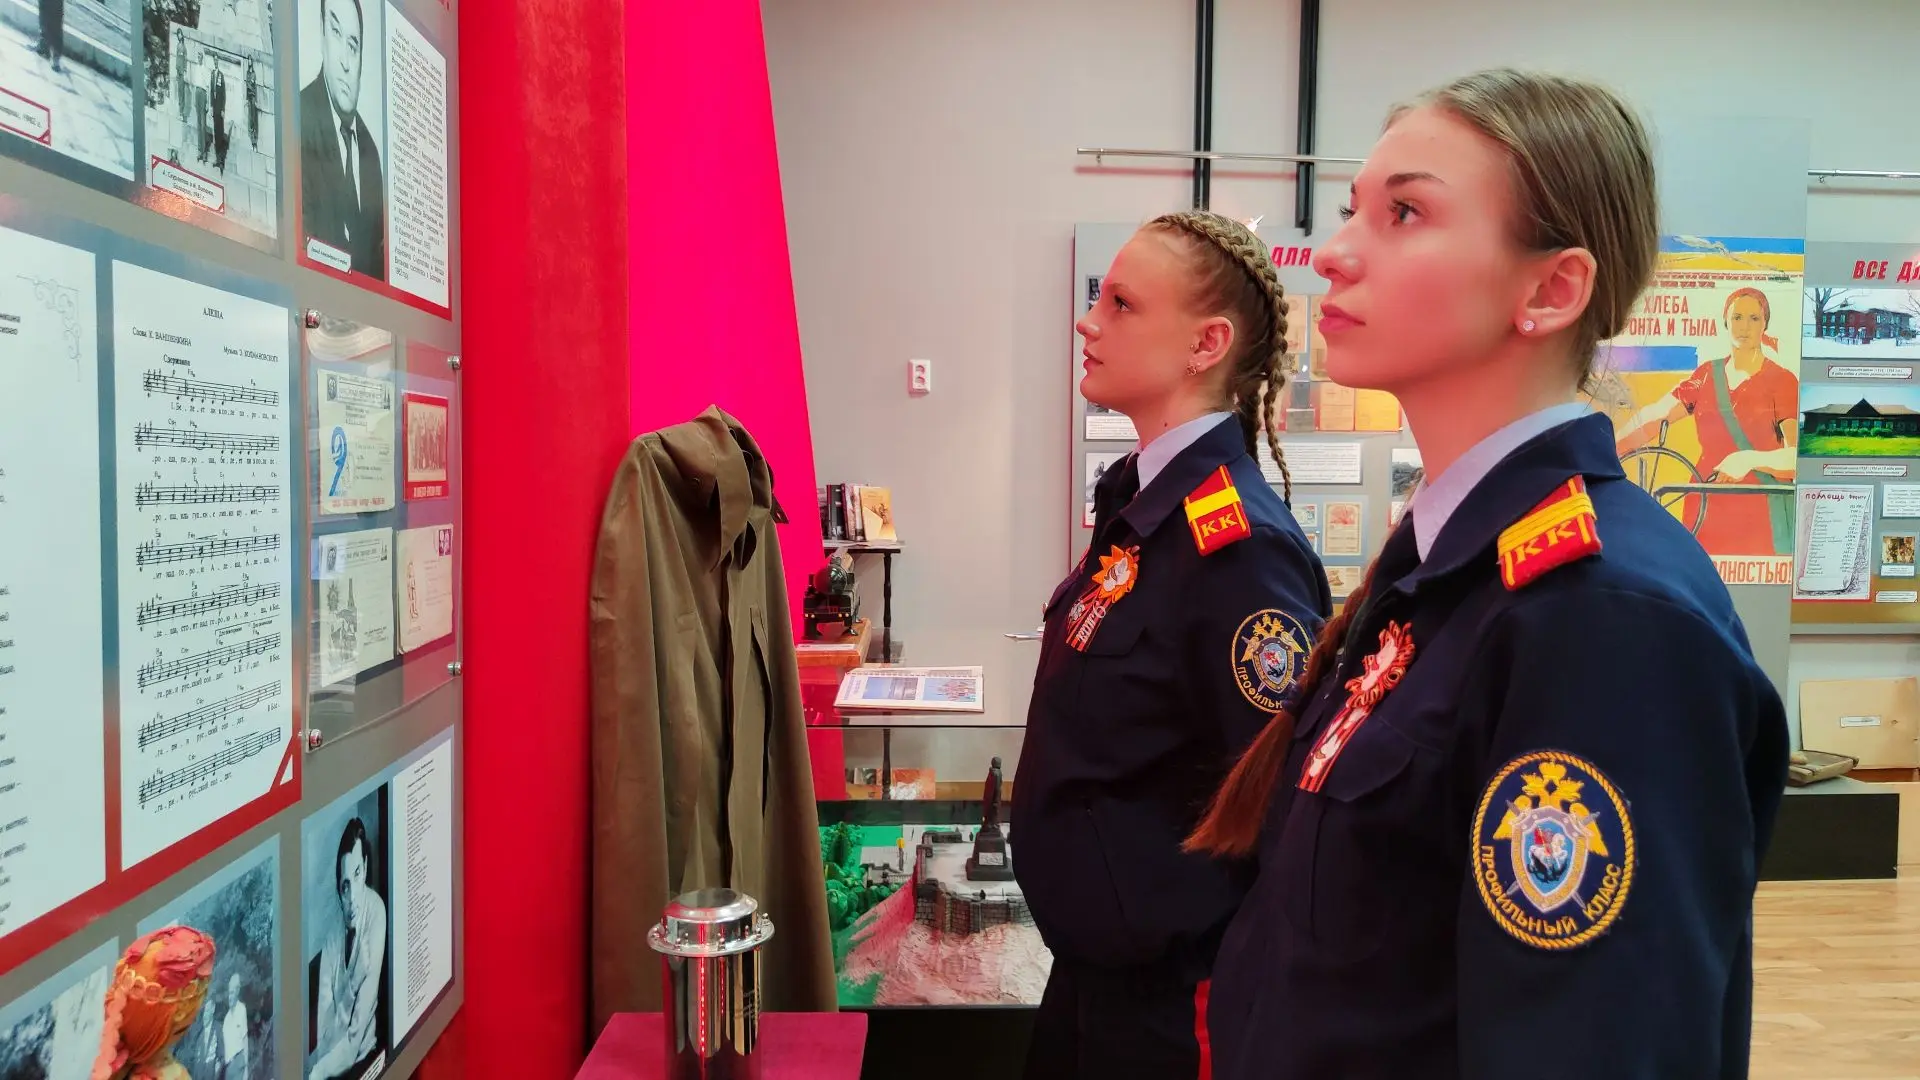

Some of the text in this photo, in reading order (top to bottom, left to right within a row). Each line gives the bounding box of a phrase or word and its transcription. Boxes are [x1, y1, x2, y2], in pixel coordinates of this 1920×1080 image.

[1271, 246, 1312, 269] ДЛЯ
[1852, 260, 1889, 280] ВСЕ
[1643, 295, 1689, 315] ХЛЕБА
[1624, 317, 1718, 337] ОНТА И ТЫЛА
[1200, 512, 1239, 538] КК
[1514, 520, 1577, 565] КК
[1236, 666, 1284, 709] ПРОФИЛЬН
[1480, 845, 1622, 936] ПРОФИЛЬНЫЙ КЛАСС
